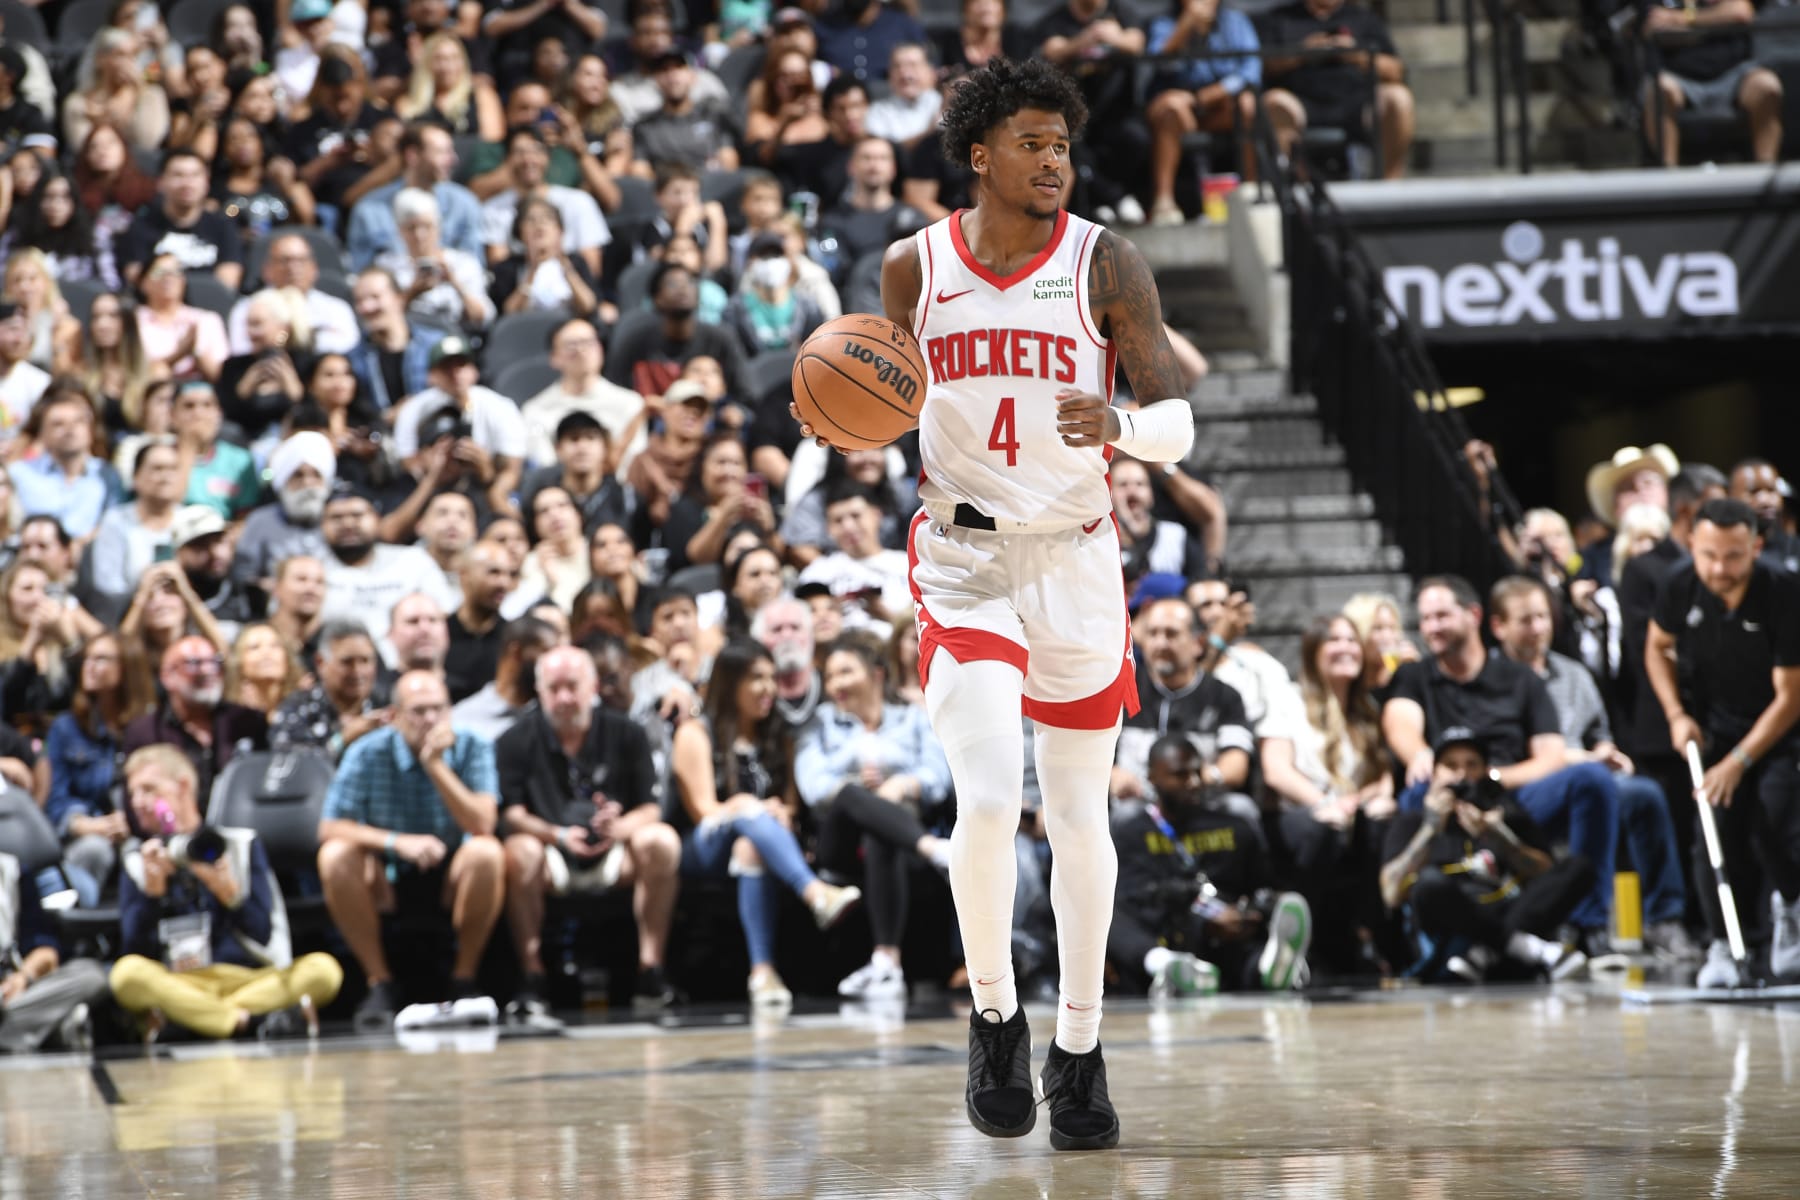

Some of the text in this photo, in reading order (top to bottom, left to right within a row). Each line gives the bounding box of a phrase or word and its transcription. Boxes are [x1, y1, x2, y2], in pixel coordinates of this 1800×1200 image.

[1033, 289, 1074, 300] karma
[1035, 277, 1073, 288] credit
[1382, 236, 1739, 328] nextiva
[843, 341, 918, 405] Wilson
[927, 328, 1077, 385] ROCKETS
[988, 397, 1020, 467] 4
